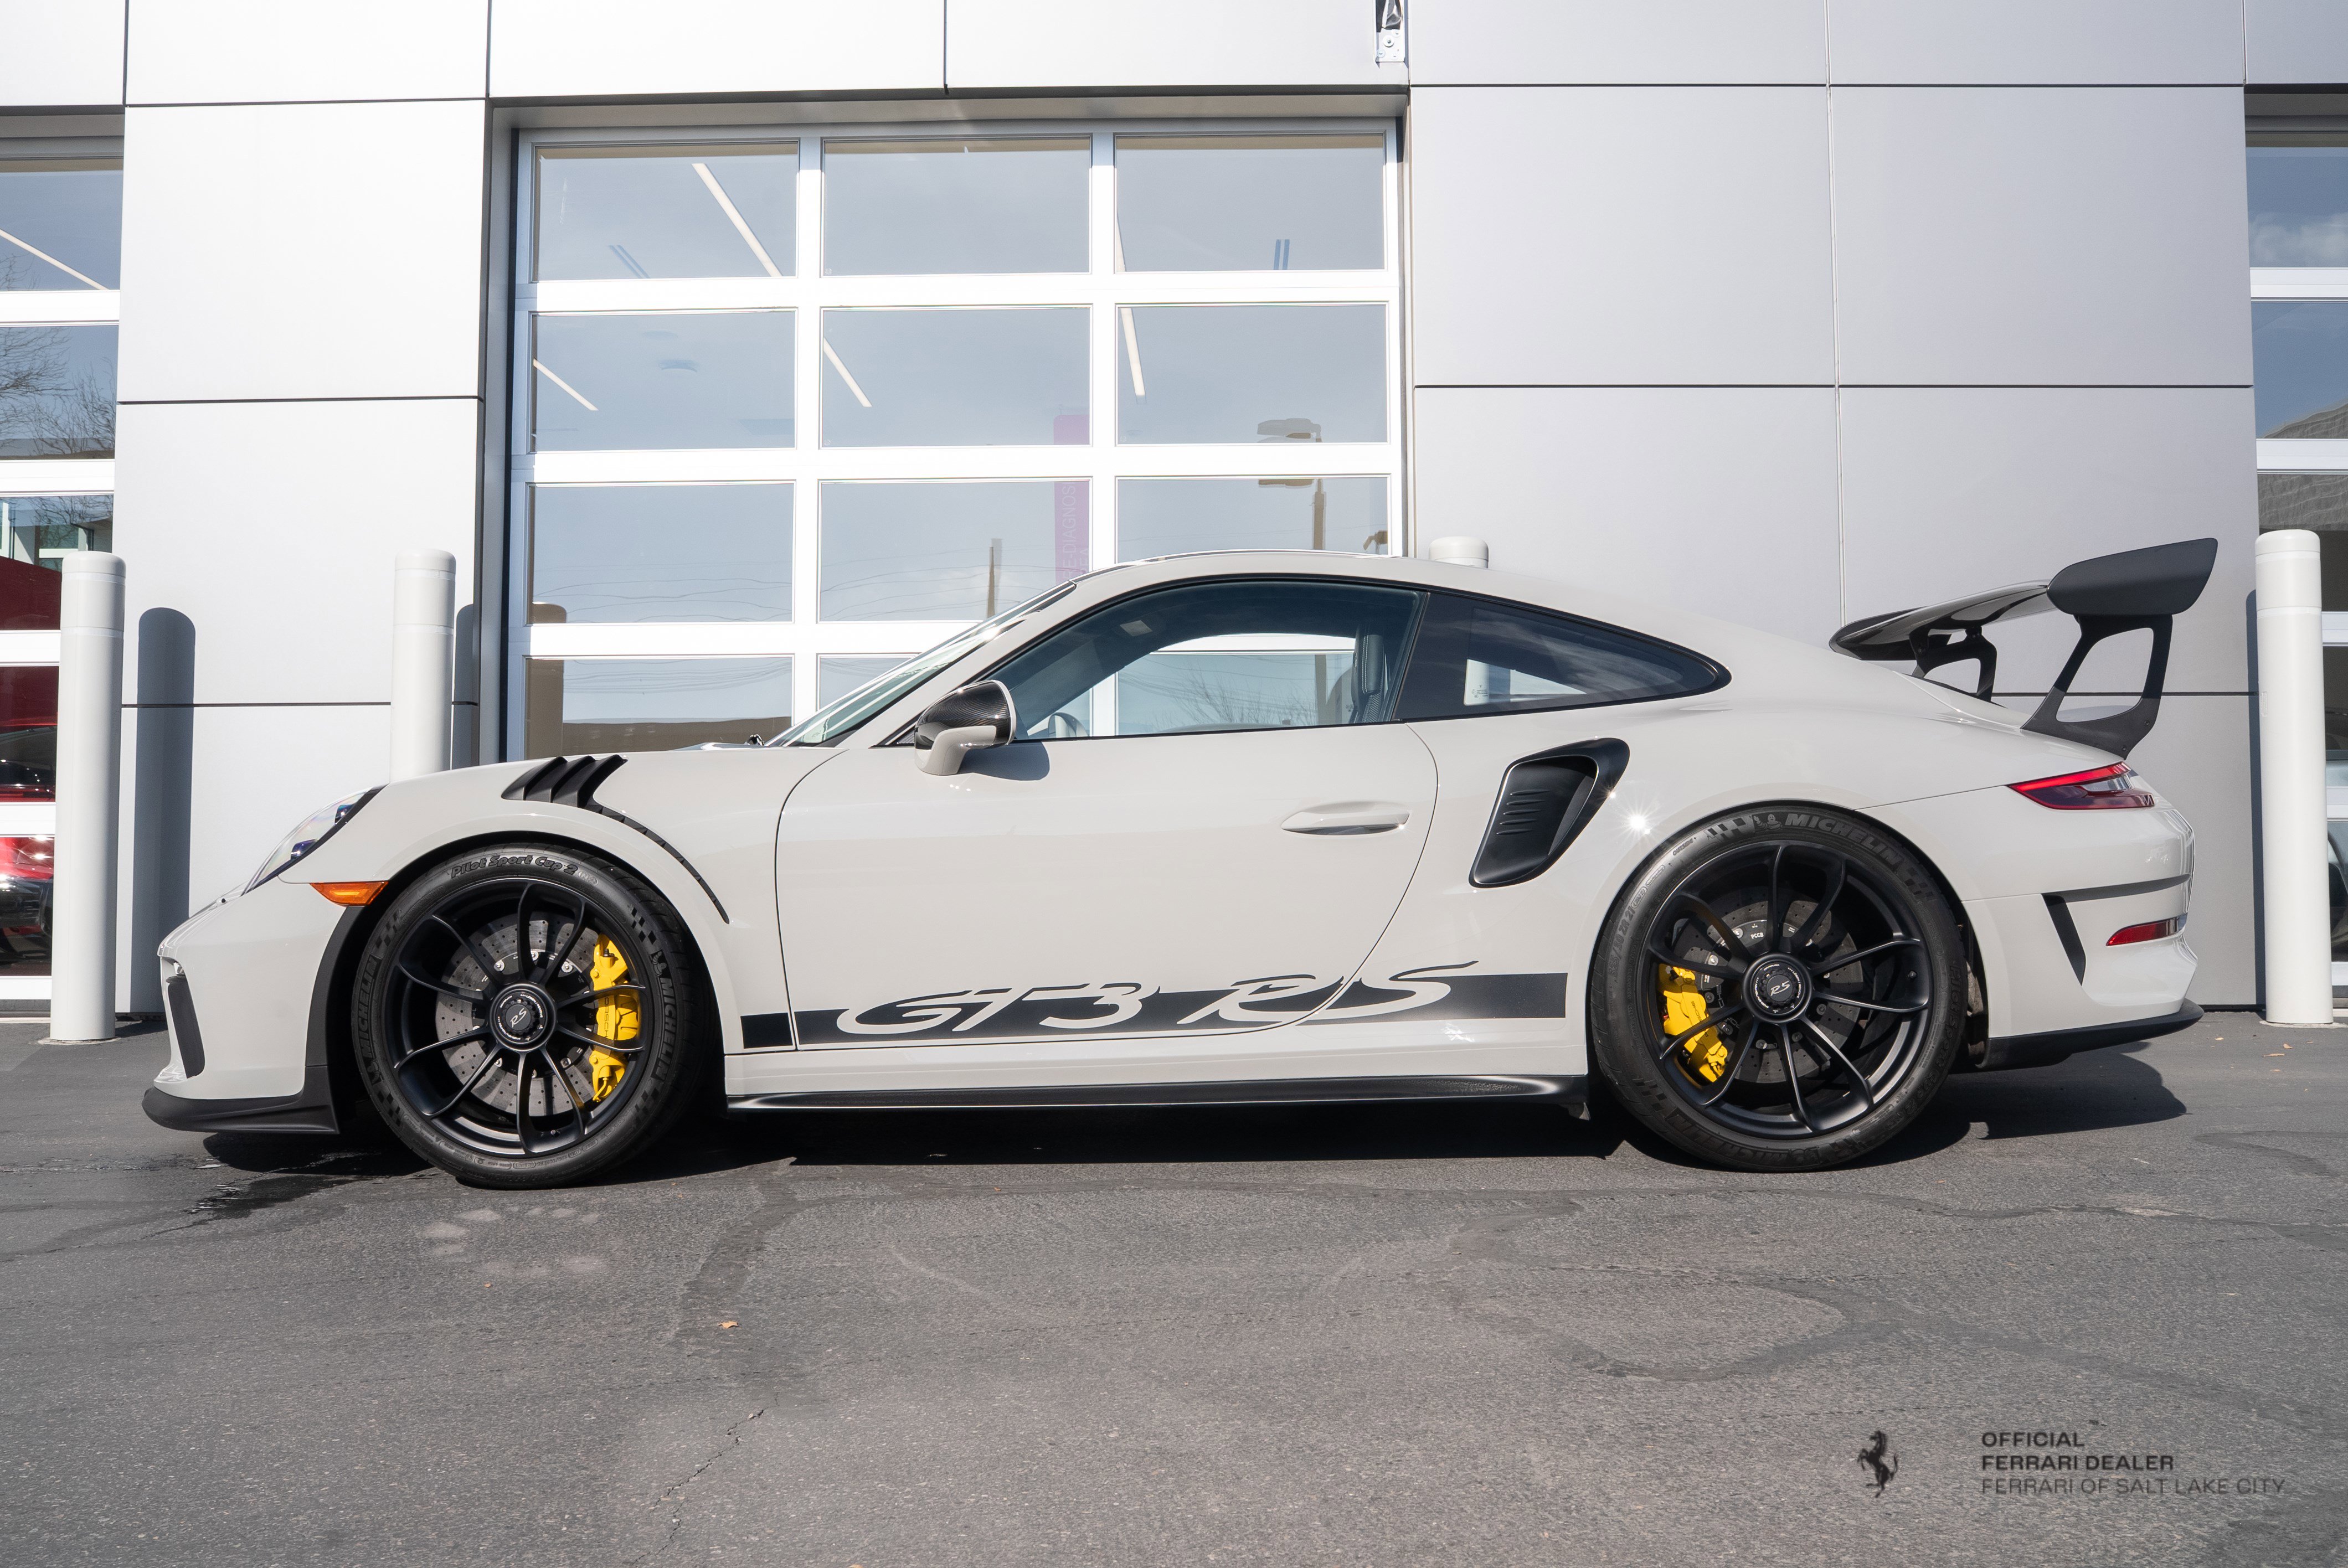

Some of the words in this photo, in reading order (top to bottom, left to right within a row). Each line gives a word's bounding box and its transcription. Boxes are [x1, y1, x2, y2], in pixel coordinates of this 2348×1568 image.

[1062, 482, 1077, 580] RE-DIAGNOSI
[1785, 813, 1903, 864] MICHELIN
[451, 858, 487, 879] Pilot
[488, 855, 533, 867] Sport
[535, 856, 563, 871] Cup
[563, 864, 579, 875] 2
[359, 957, 378, 1059] MICHELIN
[837, 982, 1157, 1035] GT3
[1770, 981, 1790, 997] RS
[510, 1007, 527, 1028] RS
[656, 978, 677, 1079] MICHELIN
